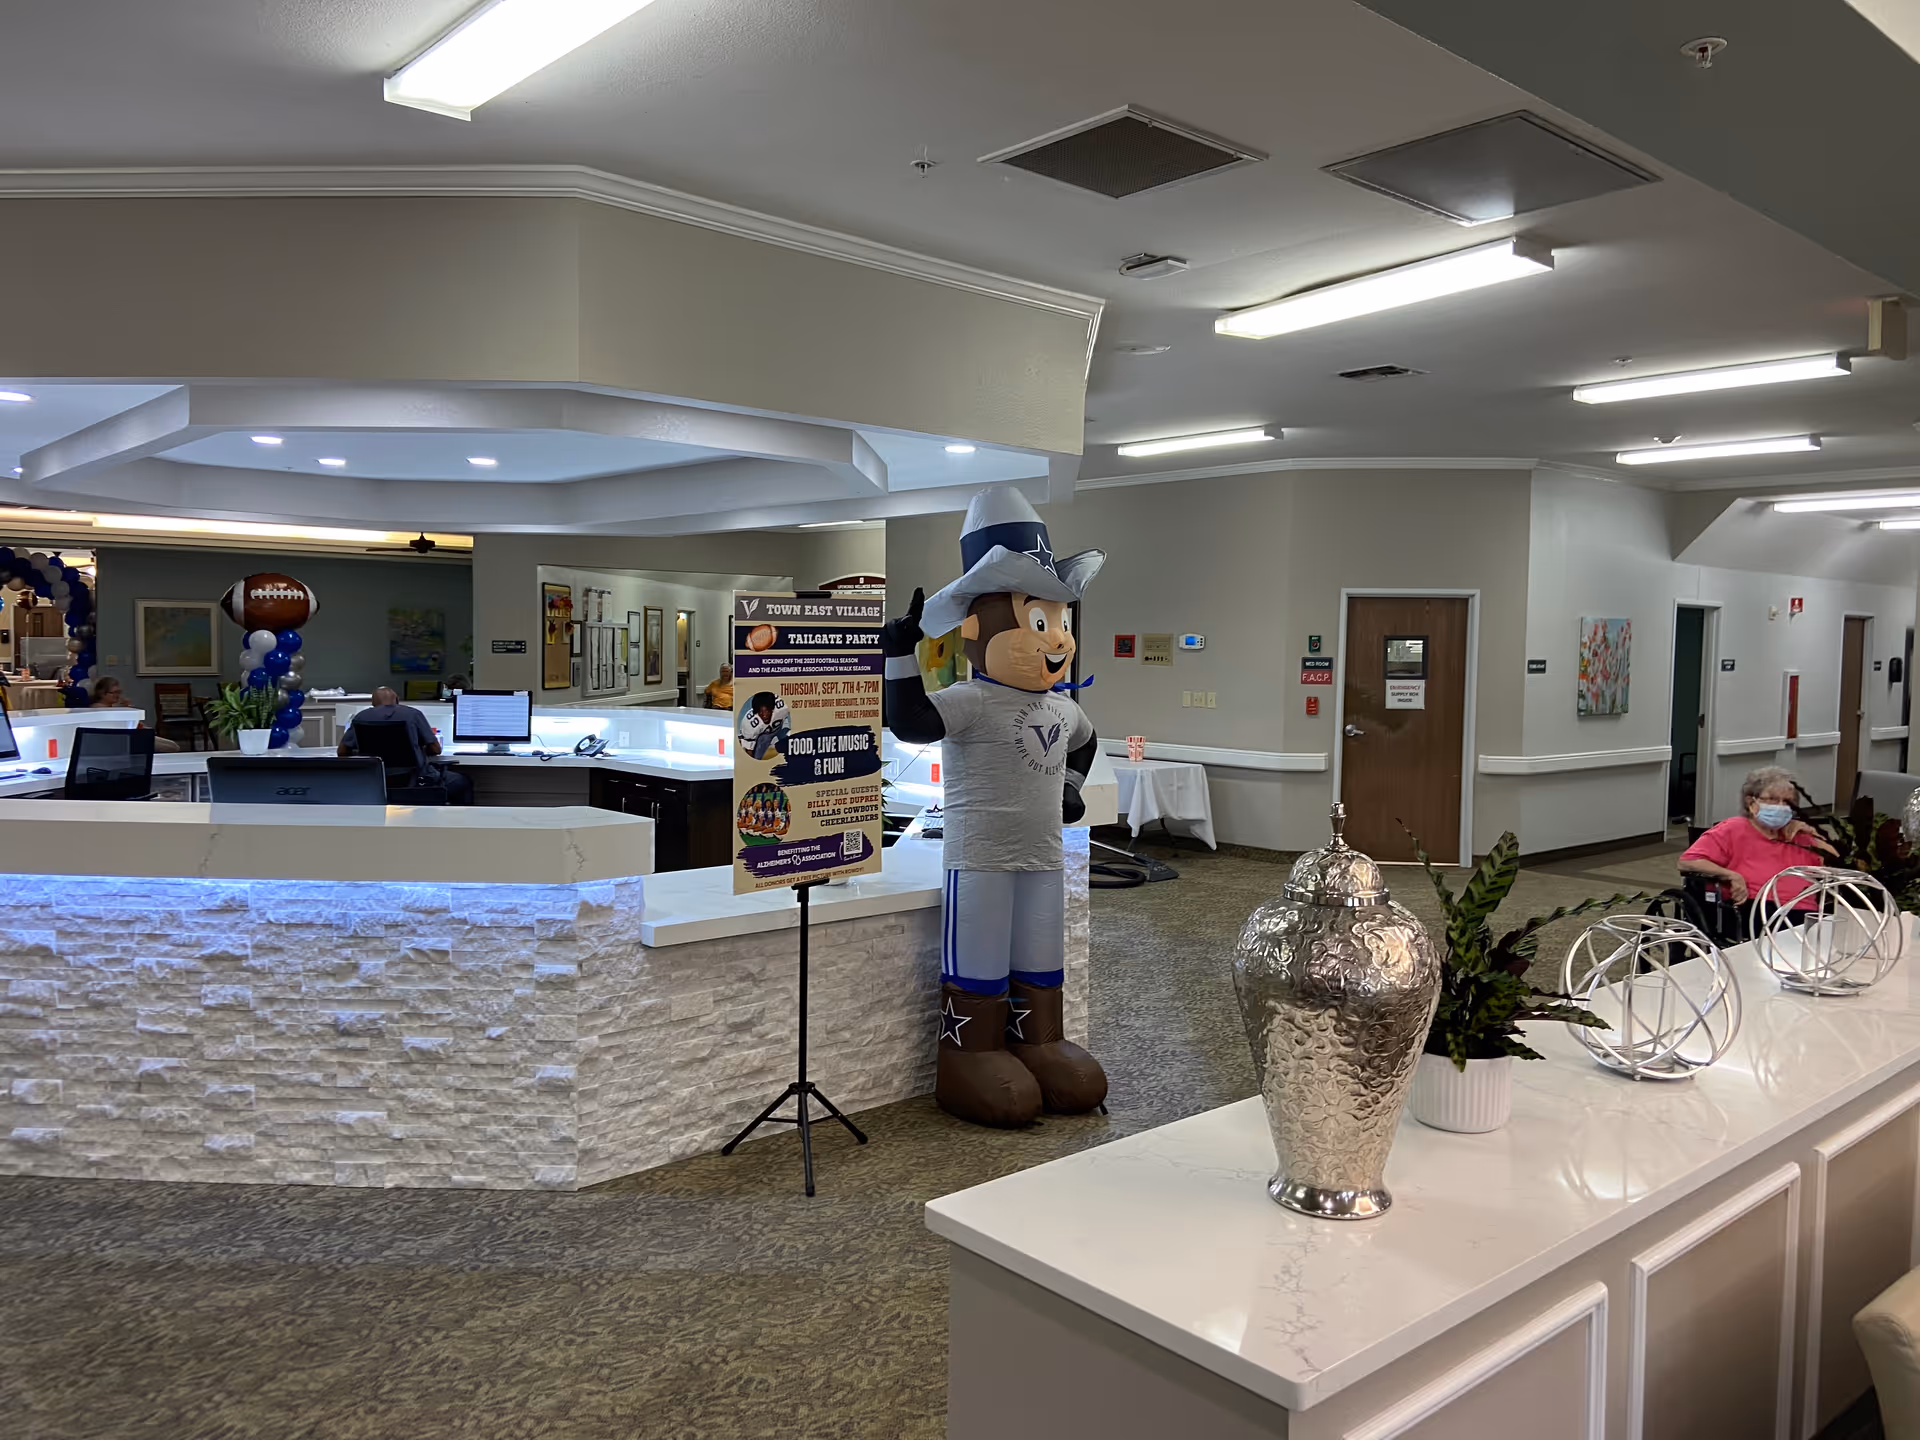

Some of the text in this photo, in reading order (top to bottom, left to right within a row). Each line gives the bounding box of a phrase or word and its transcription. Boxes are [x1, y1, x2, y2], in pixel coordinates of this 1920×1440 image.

[766, 604, 880, 616] TOWN EAST VILLAGE
[788, 634, 879, 644] TAILGATE PARTY
[780, 681, 879, 696] THURSDAY, SEPT. 7TH 4-7PM
[822, 699, 834, 707] DRIVE
[860, 698, 865, 706] TX
[835, 709, 879, 719] FREE VALET PARKING
[1013, 709, 1028, 730] JOIN
[1027, 702, 1043, 711] THE
[788, 734, 869, 756] FOOD, LIVE MUSIC
[1014, 738, 1030, 760] WIPE
[1028, 759, 1043, 772] OUT
[814, 757, 844, 775] & FUN!
[276, 786, 312, 796] acer
[816, 785, 879, 798] SPECIAL GUESTS
[807, 795, 879, 809] BILLY JOE DUPREE
[811, 804, 879, 818] DALLAS COWBOYS
[820, 814, 879, 827] CHEERLEADERS
[778, 846, 810, 856] BENEFITTING
[801, 852, 836, 862] ASSOCIATION
